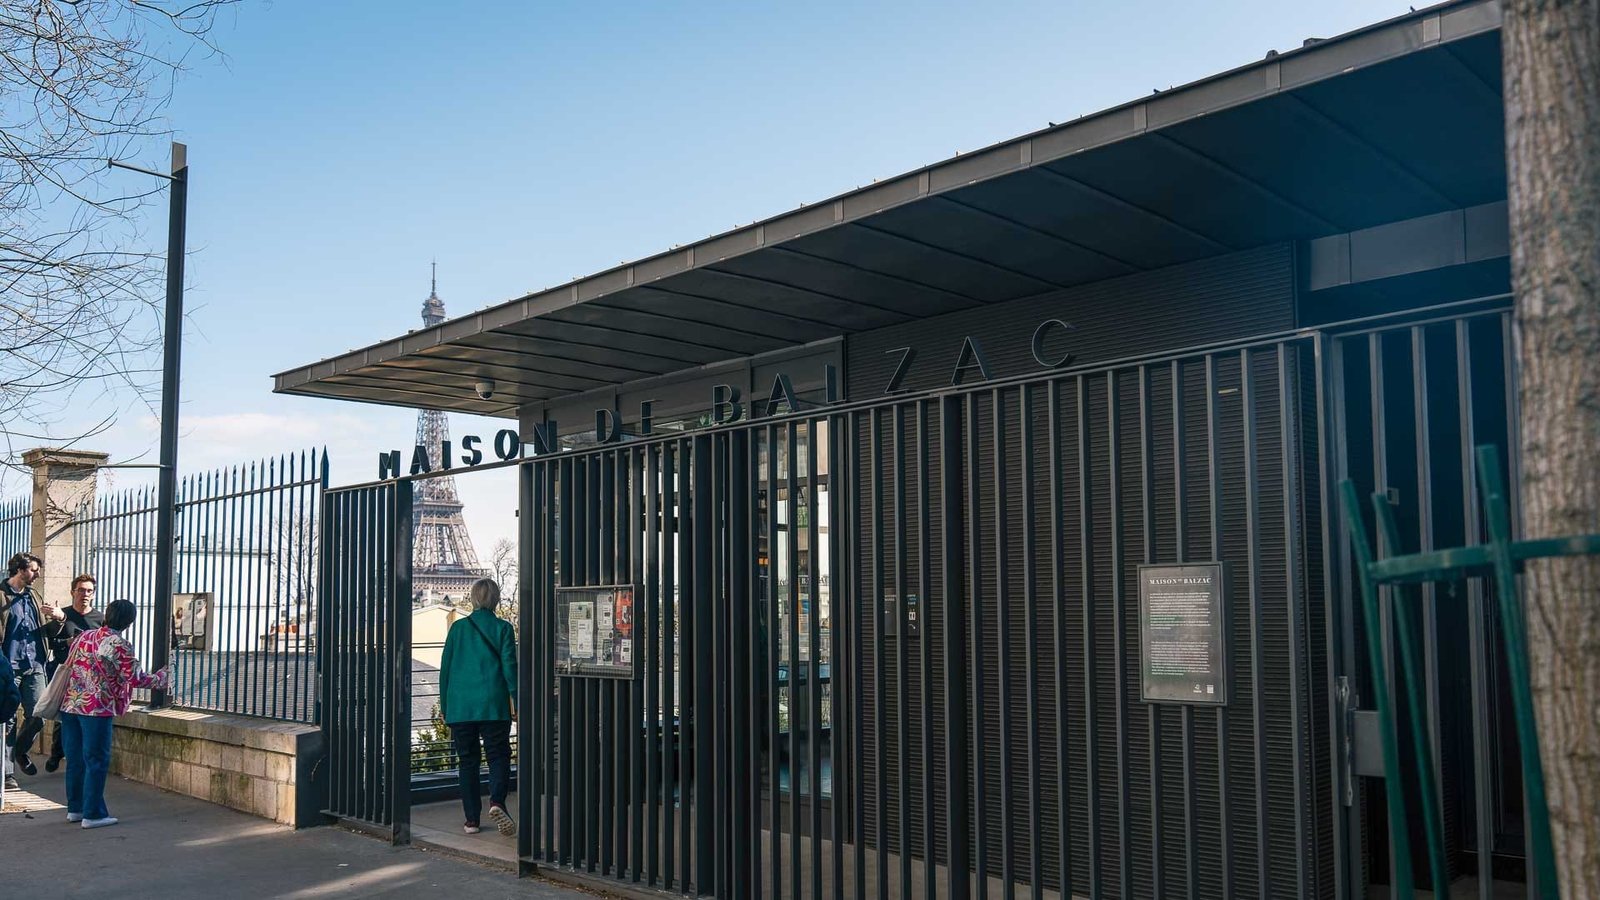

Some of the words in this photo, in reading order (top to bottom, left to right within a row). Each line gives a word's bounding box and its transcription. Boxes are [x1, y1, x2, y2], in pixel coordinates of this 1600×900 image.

[379, 420, 558, 481] MAISON
[595, 400, 656, 443] DE
[712, 318, 1076, 423] BALZAC
